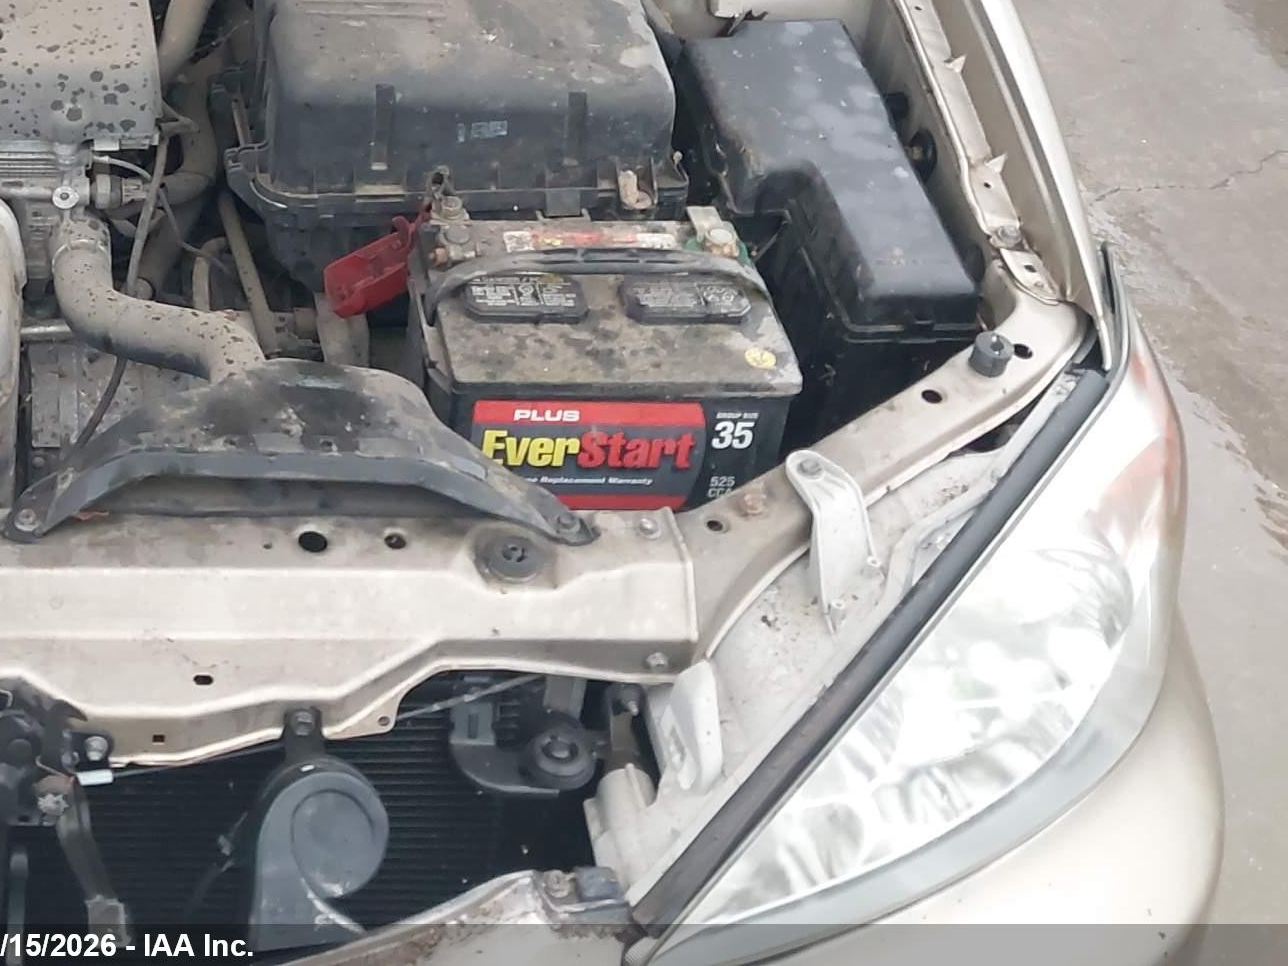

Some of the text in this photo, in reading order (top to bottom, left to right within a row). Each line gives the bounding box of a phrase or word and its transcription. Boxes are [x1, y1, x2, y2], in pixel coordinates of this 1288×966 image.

[513, 410, 580, 421] PLUS
[711, 420, 755, 449] 35
[482, 430, 695, 469] EverStart
[709, 476, 736, 487] 525
